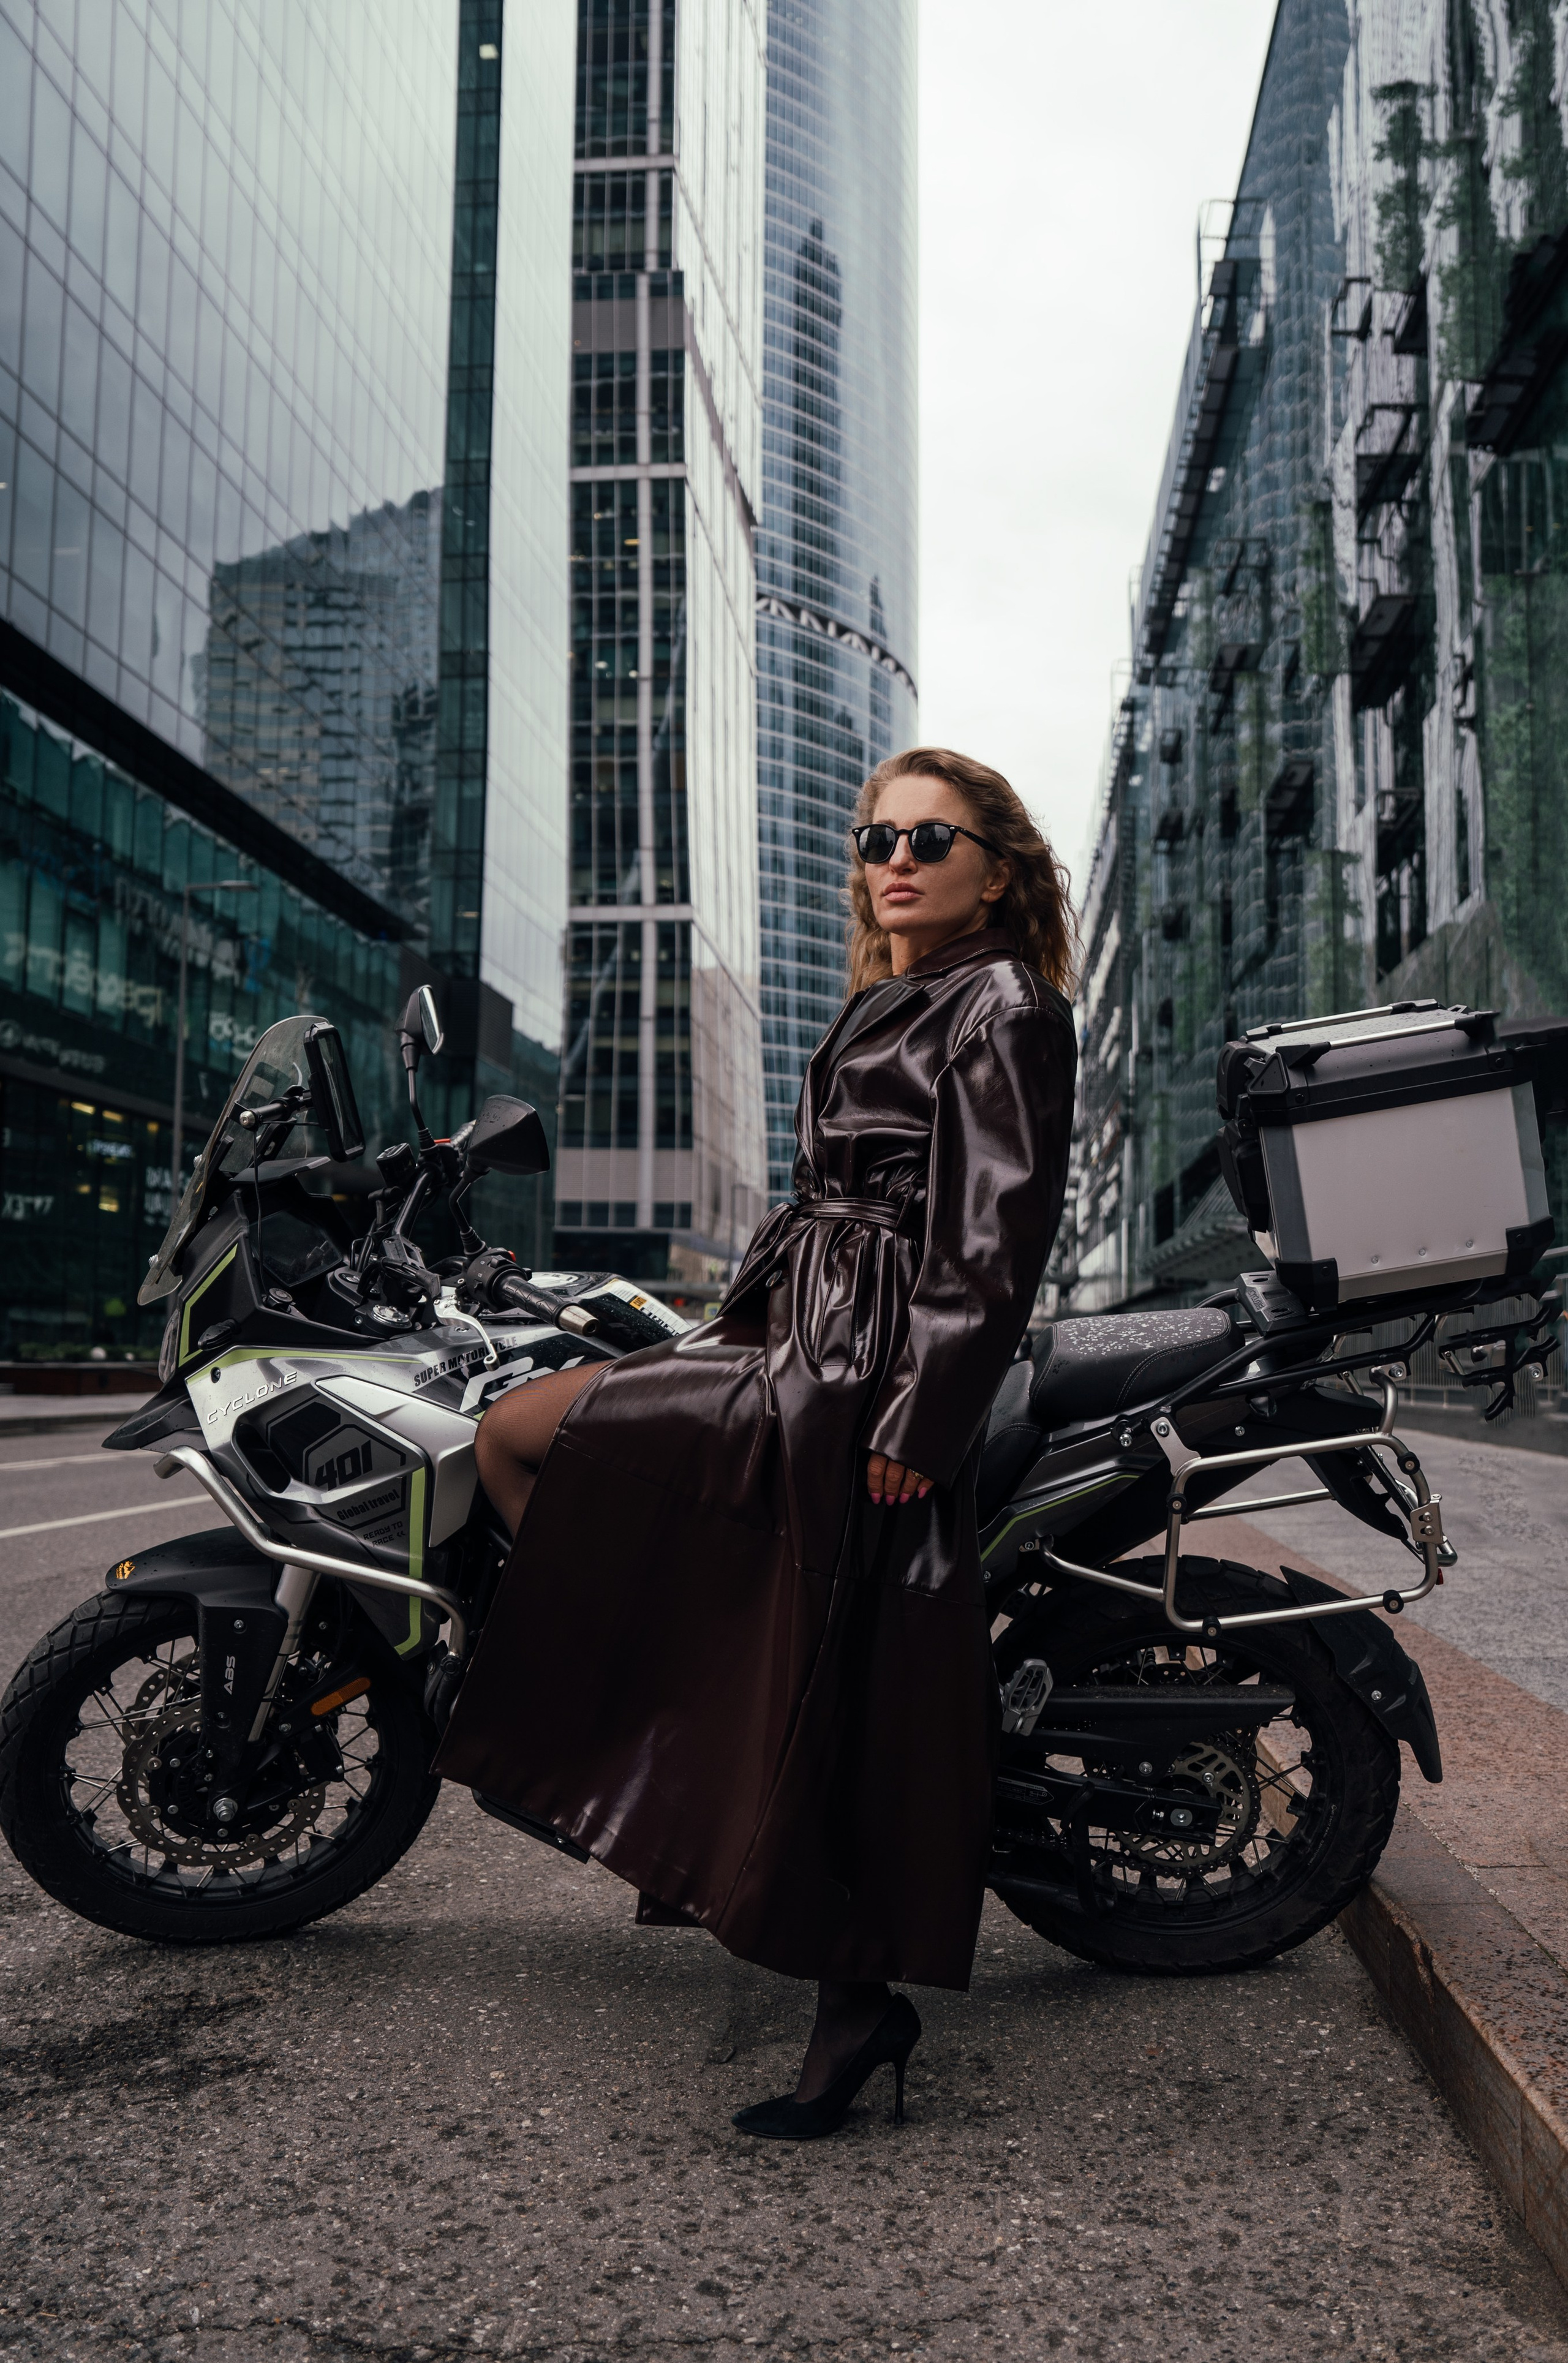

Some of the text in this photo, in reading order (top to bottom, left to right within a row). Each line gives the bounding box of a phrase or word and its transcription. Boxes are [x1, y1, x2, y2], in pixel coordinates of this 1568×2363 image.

[413, 1361, 447, 1387] SUPER
[207, 1371, 297, 1425] CYCLONE
[314, 1439, 373, 1491] 401
[337, 1489, 400, 1521] Global travel
[363, 1521, 403, 1540] READY TO
[372, 1534, 394, 1547] RACE
[224, 1655, 236, 1695] ABS
